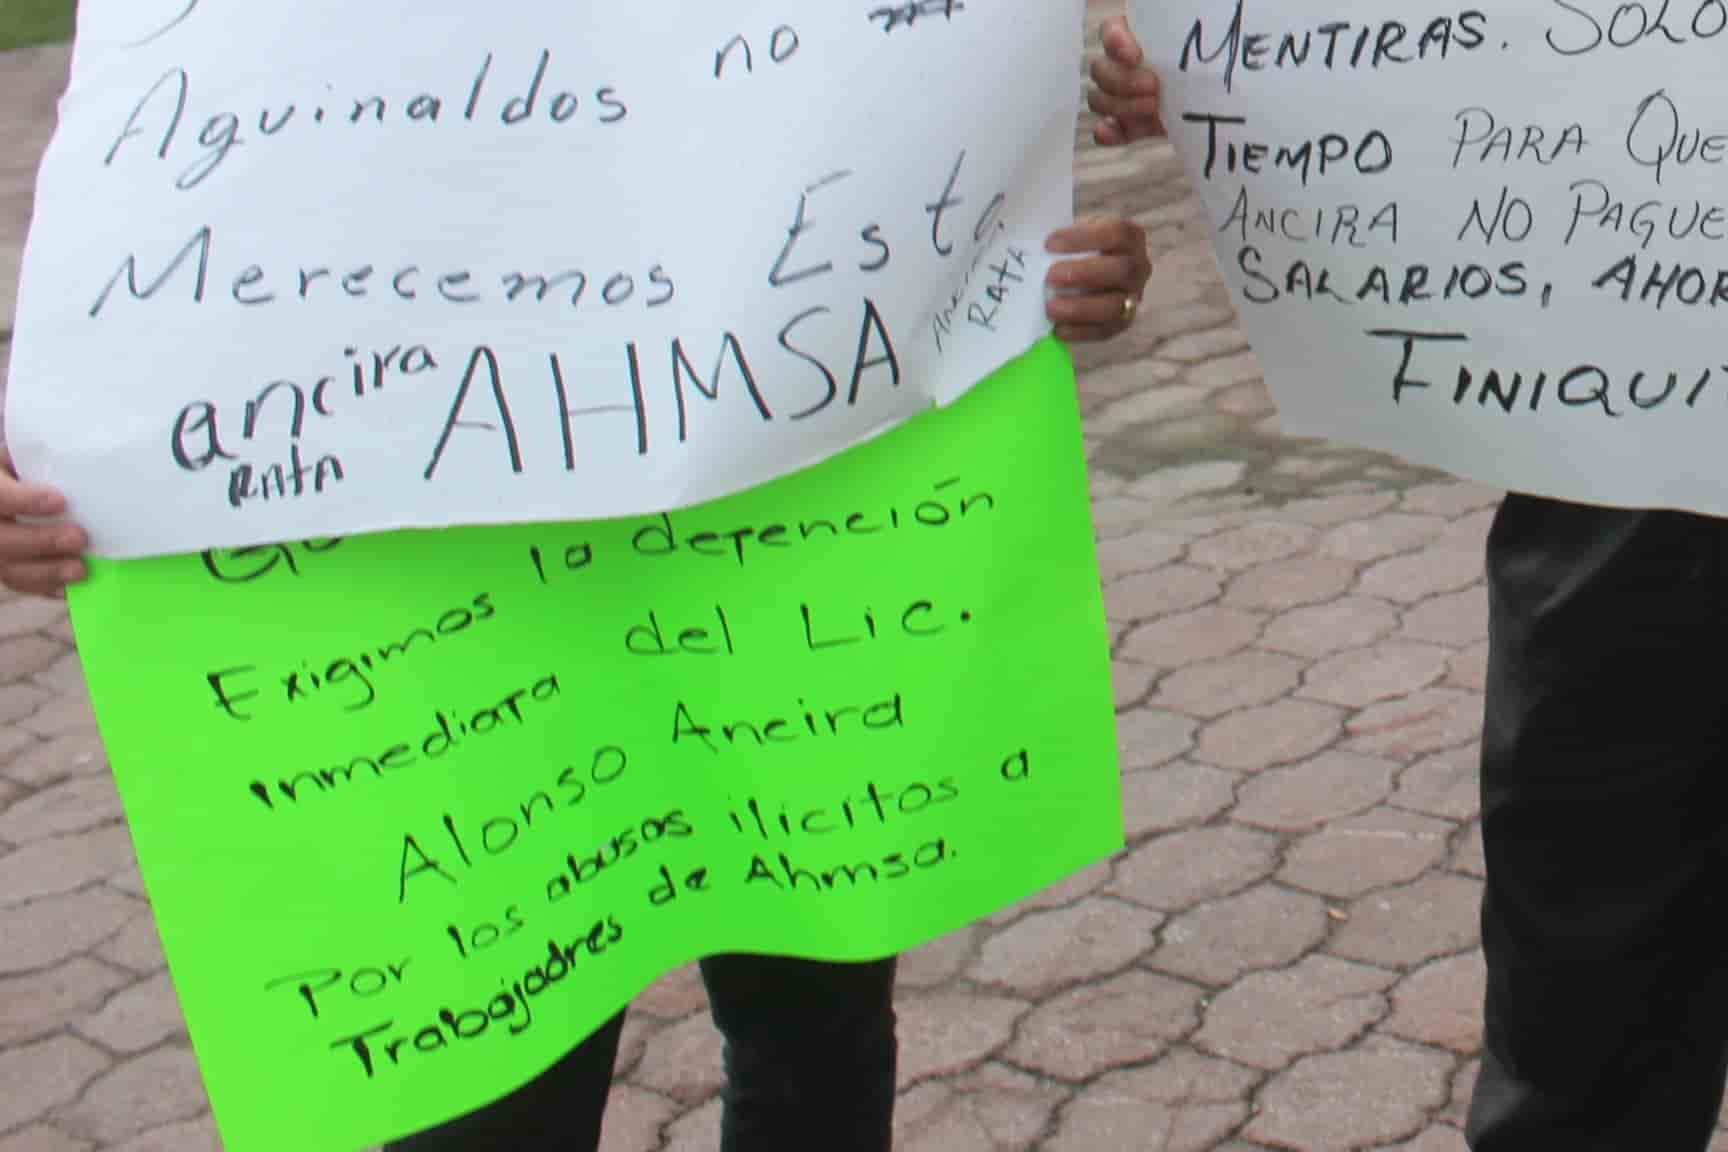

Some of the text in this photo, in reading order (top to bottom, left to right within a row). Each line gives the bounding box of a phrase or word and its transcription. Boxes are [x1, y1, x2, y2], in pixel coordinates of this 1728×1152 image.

[105, 24, 799, 190] Aguinaldos no
[1182, 112, 1393, 185] TIEMPO
[1448, 107, 1588, 169] PARA
[1626, 88, 1728, 184] QUE
[89, 225, 676, 317] Merecemos
[1218, 184, 1398, 246] ANCIRA
[1457, 186, 1532, 245] NO
[1564, 178, 1728, 249] PAGUE
[171, 298, 901, 479] ancira AHMSA
[207, 592, 495, 721] Exigimos
[530, 543, 593, 584] la
[625, 604, 734, 656] del
[800, 599, 971, 651] Lic.
[264, 956, 412, 1018] Por
[447, 905, 525, 958] los
[547, 809, 693, 902] abusos
[1001, 748, 1029, 781] a
[399, 745, 627, 904] Alonso
[648, 864, 711, 907] de
